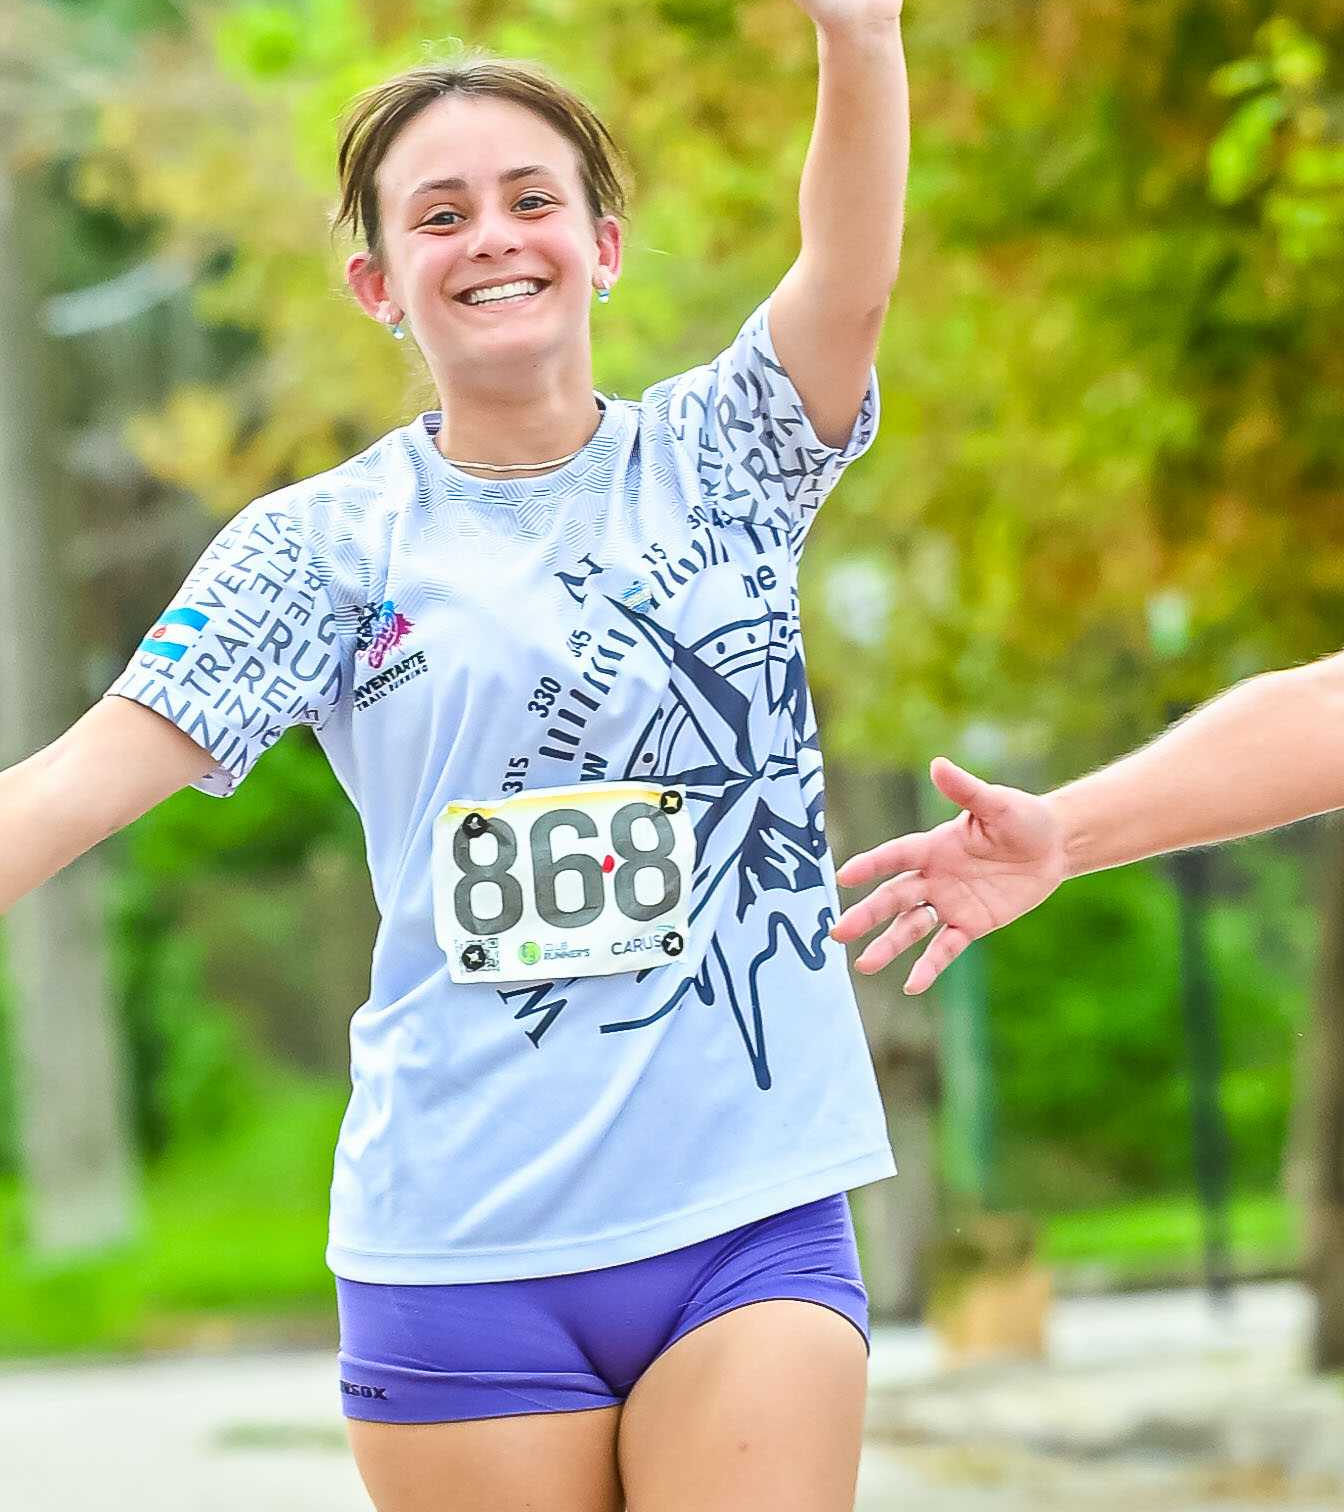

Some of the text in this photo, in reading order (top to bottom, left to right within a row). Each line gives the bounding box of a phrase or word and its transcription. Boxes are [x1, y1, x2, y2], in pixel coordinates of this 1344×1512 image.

[179, 608, 271, 696] TRAIL
[527, 676, 562, 719] 330
[502, 756, 529, 793] 315
[452, 801, 682, 936] 868
[611, 934, 663, 957] CARUS
